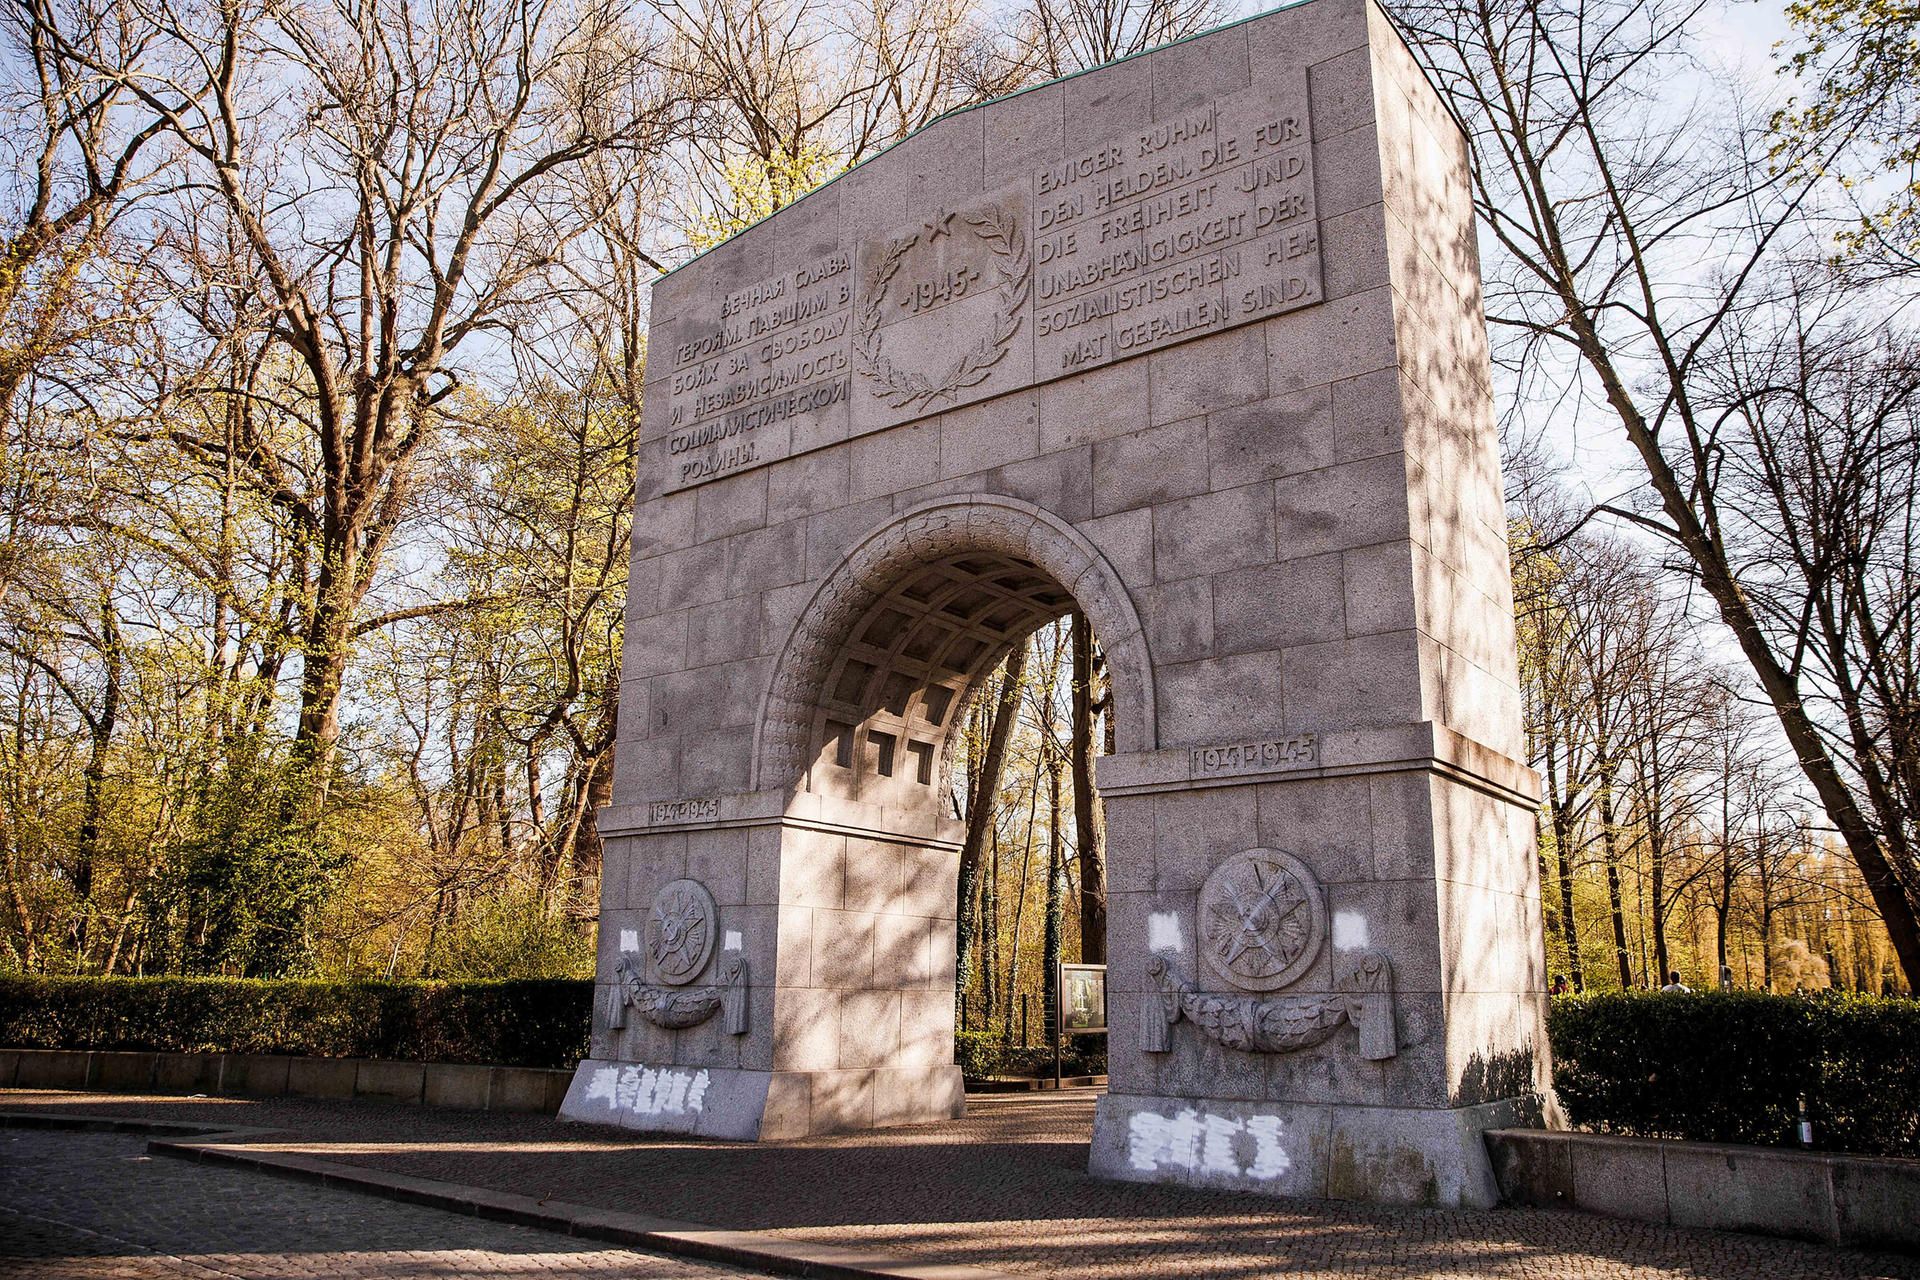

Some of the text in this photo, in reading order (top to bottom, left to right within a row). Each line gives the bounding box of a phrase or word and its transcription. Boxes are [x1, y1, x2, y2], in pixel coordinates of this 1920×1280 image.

[1038, 109, 1212, 195] EWIGER RUHM
[1038, 118, 1302, 230] DEN HELDEN, DIE FÜR
[1039, 157, 1305, 265] DIE FREIHEIT UND
[1039, 194, 1307, 299] UNABHÄNGIGKEIT DER
[721, 253, 851, 319] ВЕЧНАЯ СЛАВА
[747, 290, 828, 338] ПАВШИМ
[839, 286, 850, 304] В
[1038, 252, 1240, 336] SOZIALISTISCHEN
[1062, 278, 1312, 368] MAT GEFALLEN SIND.
[671, 350, 848, 425] И НЕЗАВИСИМОСТЬ
[673, 314, 849, 395] БОЯХ ЗА СВОБОДУ
[670, 378, 847, 455] СОЦИАЛИСТИЧЕСКОЙ
[681, 442, 760, 482] РОДИНЫ.
